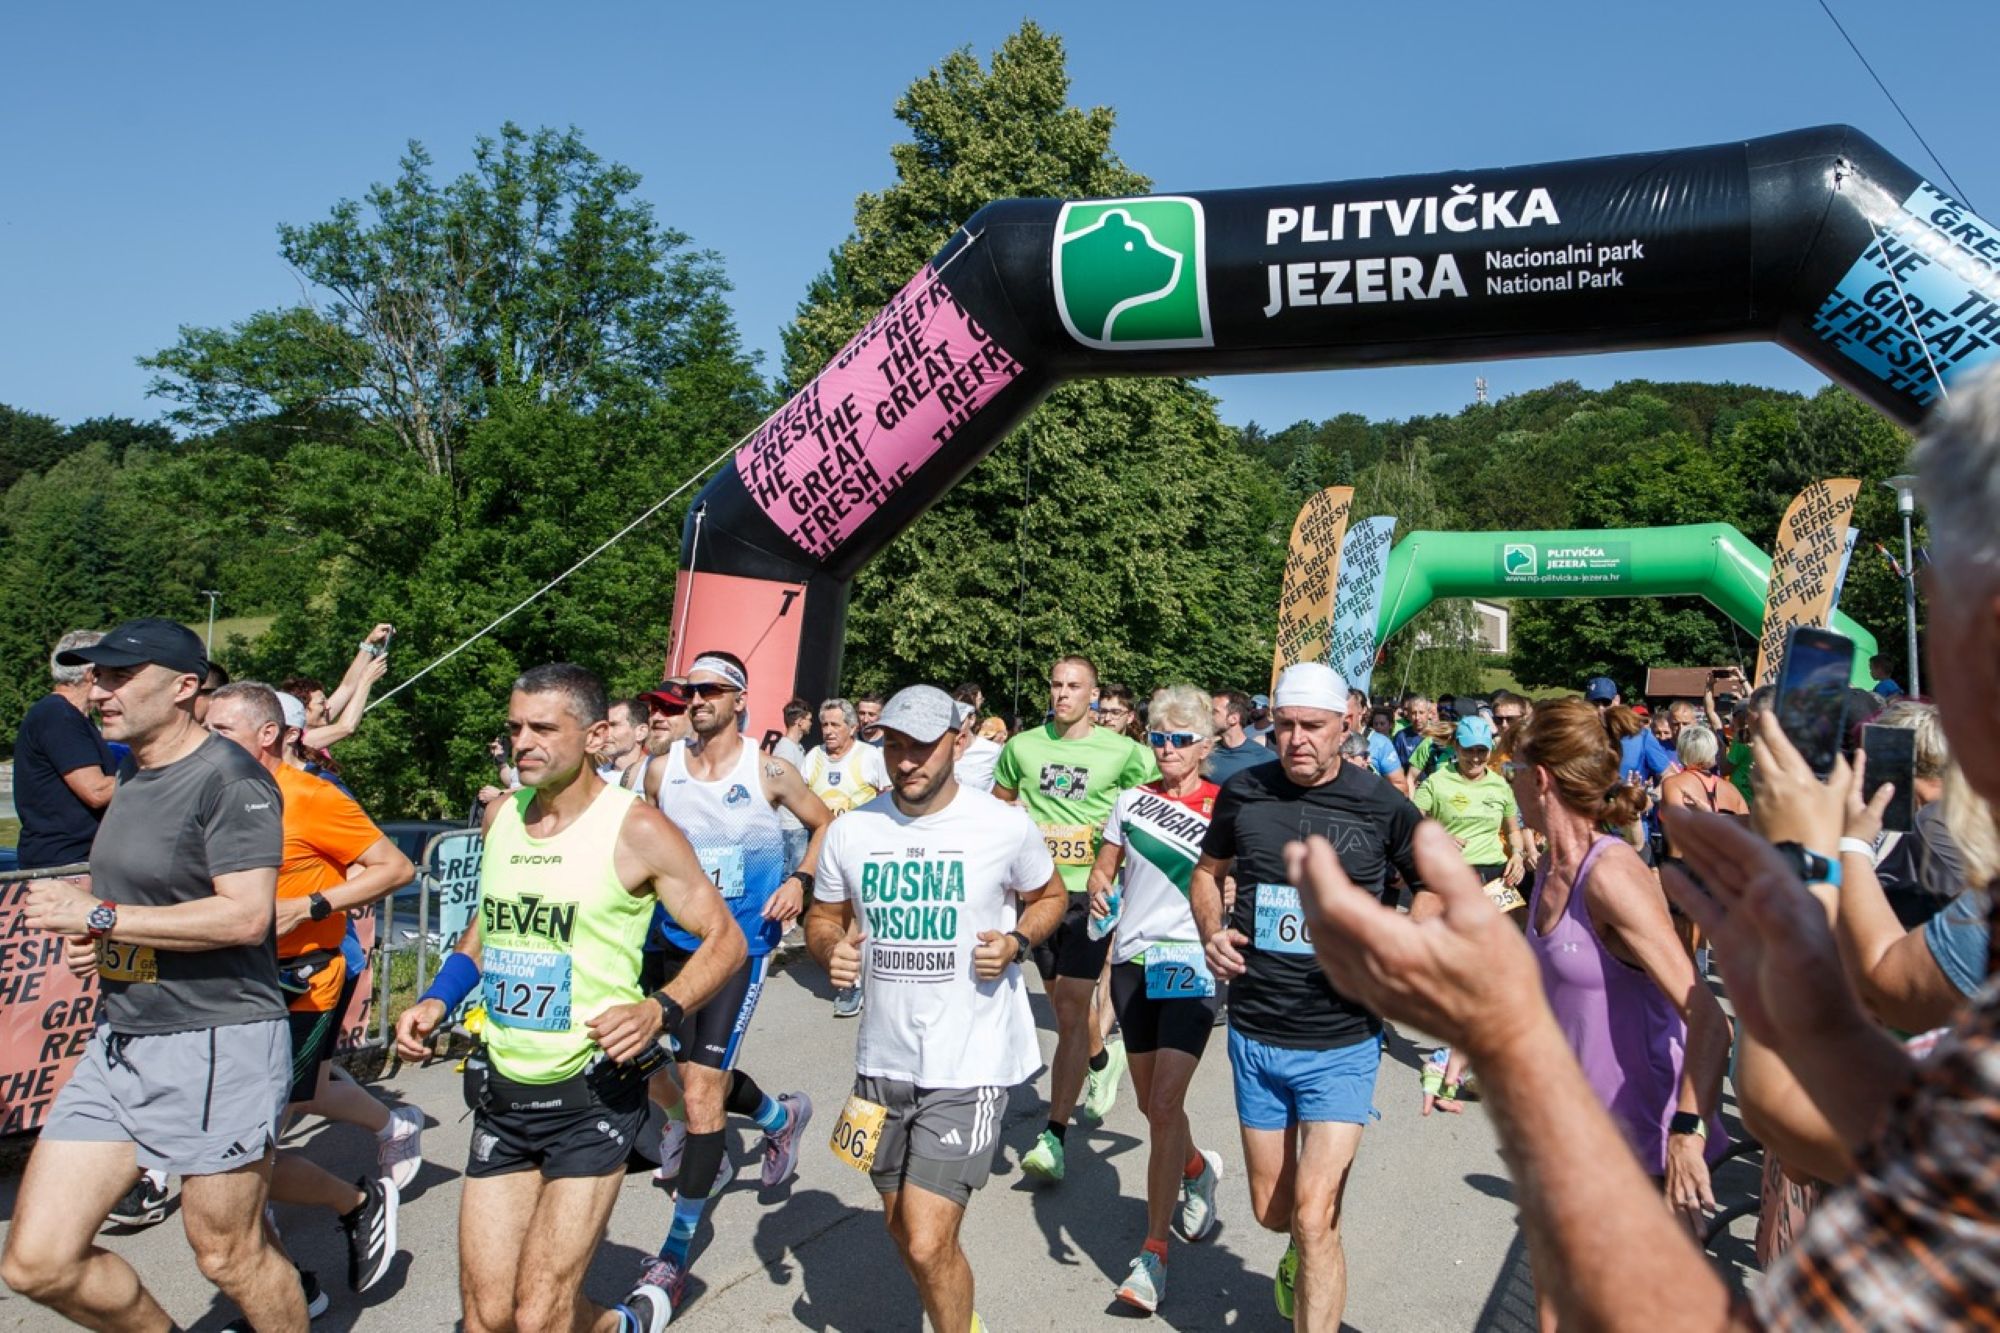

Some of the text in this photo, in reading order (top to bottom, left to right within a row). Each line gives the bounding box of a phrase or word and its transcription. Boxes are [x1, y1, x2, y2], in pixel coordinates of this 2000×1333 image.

[1265, 183, 1561, 245] PLITVIČKA
[1486, 240, 1644, 271] Nacionalni park
[1264, 253, 1469, 318] JEZERA
[1486, 268, 1624, 296] National Park
[1862, 280, 1990, 363] GREAT
[877, 325, 931, 387] THE
[876, 339, 955, 431] GREAT
[812, 393, 863, 452] THE
[788, 428, 866, 516] GREAT
[1309, 489, 1330, 511] THE
[1801, 480, 1830, 503] THE
[1299, 500, 1333, 534] GREAT
[1301, 501, 1350, 547] REFRESH
[1789, 491, 1832, 528] GREAT
[1793, 493, 1855, 542] REFRESH
[1313, 527, 1335, 551] THE
[1343, 526, 1377, 557] GREAT
[1353, 518, 1373, 538] THE
[1807, 523, 1836, 548] THE
[1284, 552, 1306, 576] THE
[1303, 542, 1338, 577] GREAT
[1346, 527, 1394, 568] REFRESH
[1357, 552, 1379, 574] THE
[1547, 546, 1605, 558] PLITVIČKA
[1547, 559, 1588, 570] JEZERA
[1773, 548, 1798, 573] THE
[1796, 537, 1838, 574] GREAT
[1283, 565, 1330, 609] REFRESH
[1307, 582, 1329, 606] THE
[1349, 563, 1382, 594] GREAT
[1504, 573, 1620, 583] www.np-plitvicka-jezera.hr
[1769, 561, 1829, 611] REFRESH
[1798, 580, 1826, 605] THE
[1352, 597, 1374, 620] THE
[1277, 613, 1311, 648] GREAT
[1281, 616, 1330, 661] REFRESH
[1329, 628, 1373, 668] REFRESH
[510, 855, 562, 865] GIVOVA
[862, 860, 966, 903] BOSNA
[865, 905, 957, 941] VISOKO
[484, 960, 536, 977] MARATON
[1164, 967, 1196, 989] 72
[494, 980, 557, 1018] 127
[39, 1027, 96, 1063] RE
